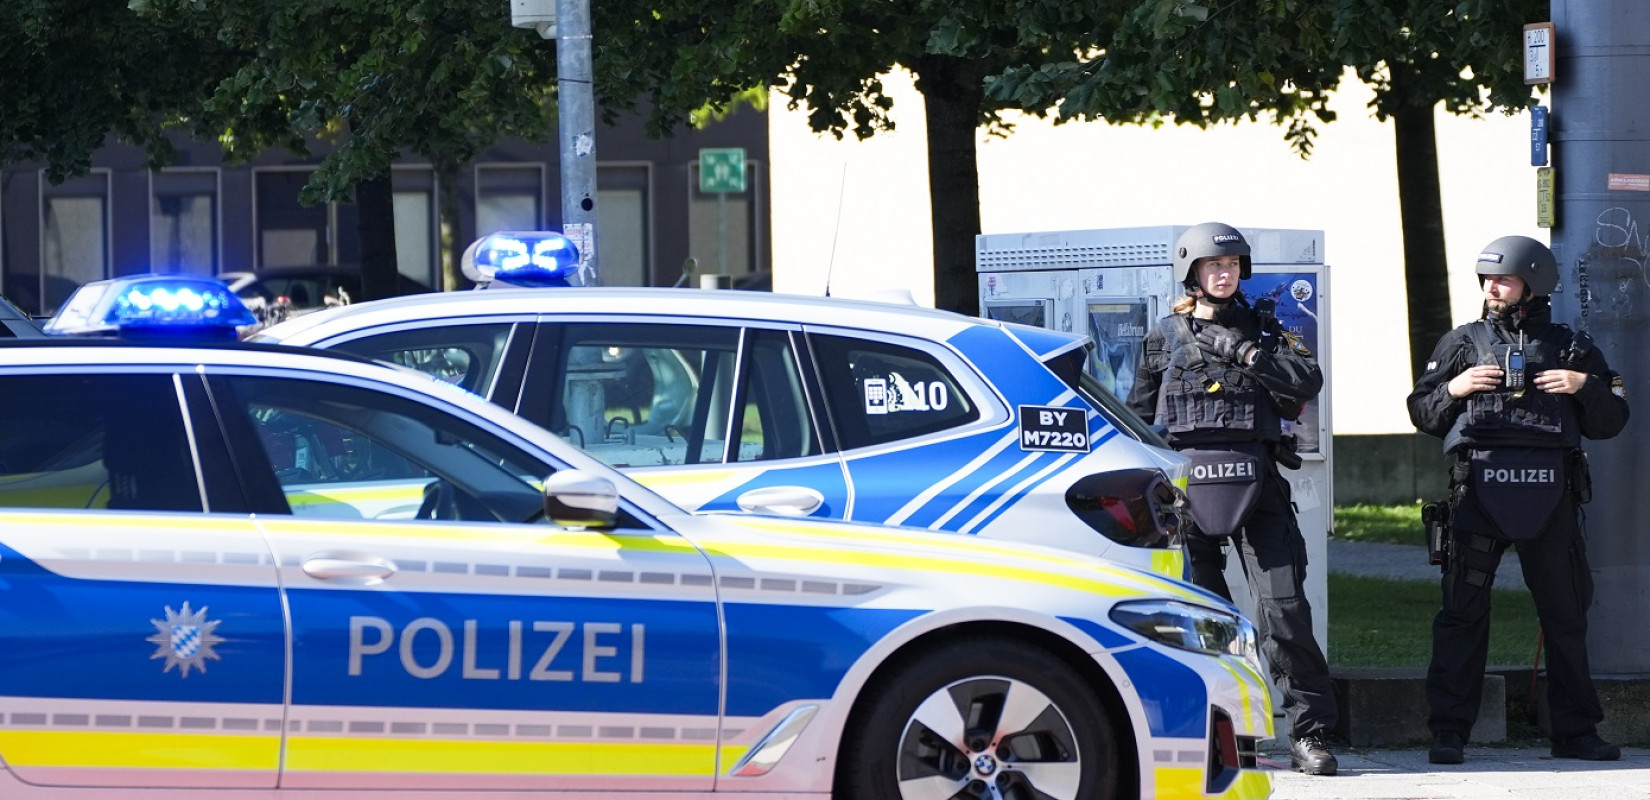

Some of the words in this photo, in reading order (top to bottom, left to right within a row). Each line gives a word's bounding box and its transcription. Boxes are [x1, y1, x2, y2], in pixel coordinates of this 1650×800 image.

[1534, 30, 1544, 43] 200
[1039, 411, 1068, 427] BY
[1024, 430, 1086, 448] M7220
[1190, 462, 1253, 479] OLIZEI
[1483, 468, 1555, 483] POLIZEI
[348, 616, 645, 683] POLIZEI
